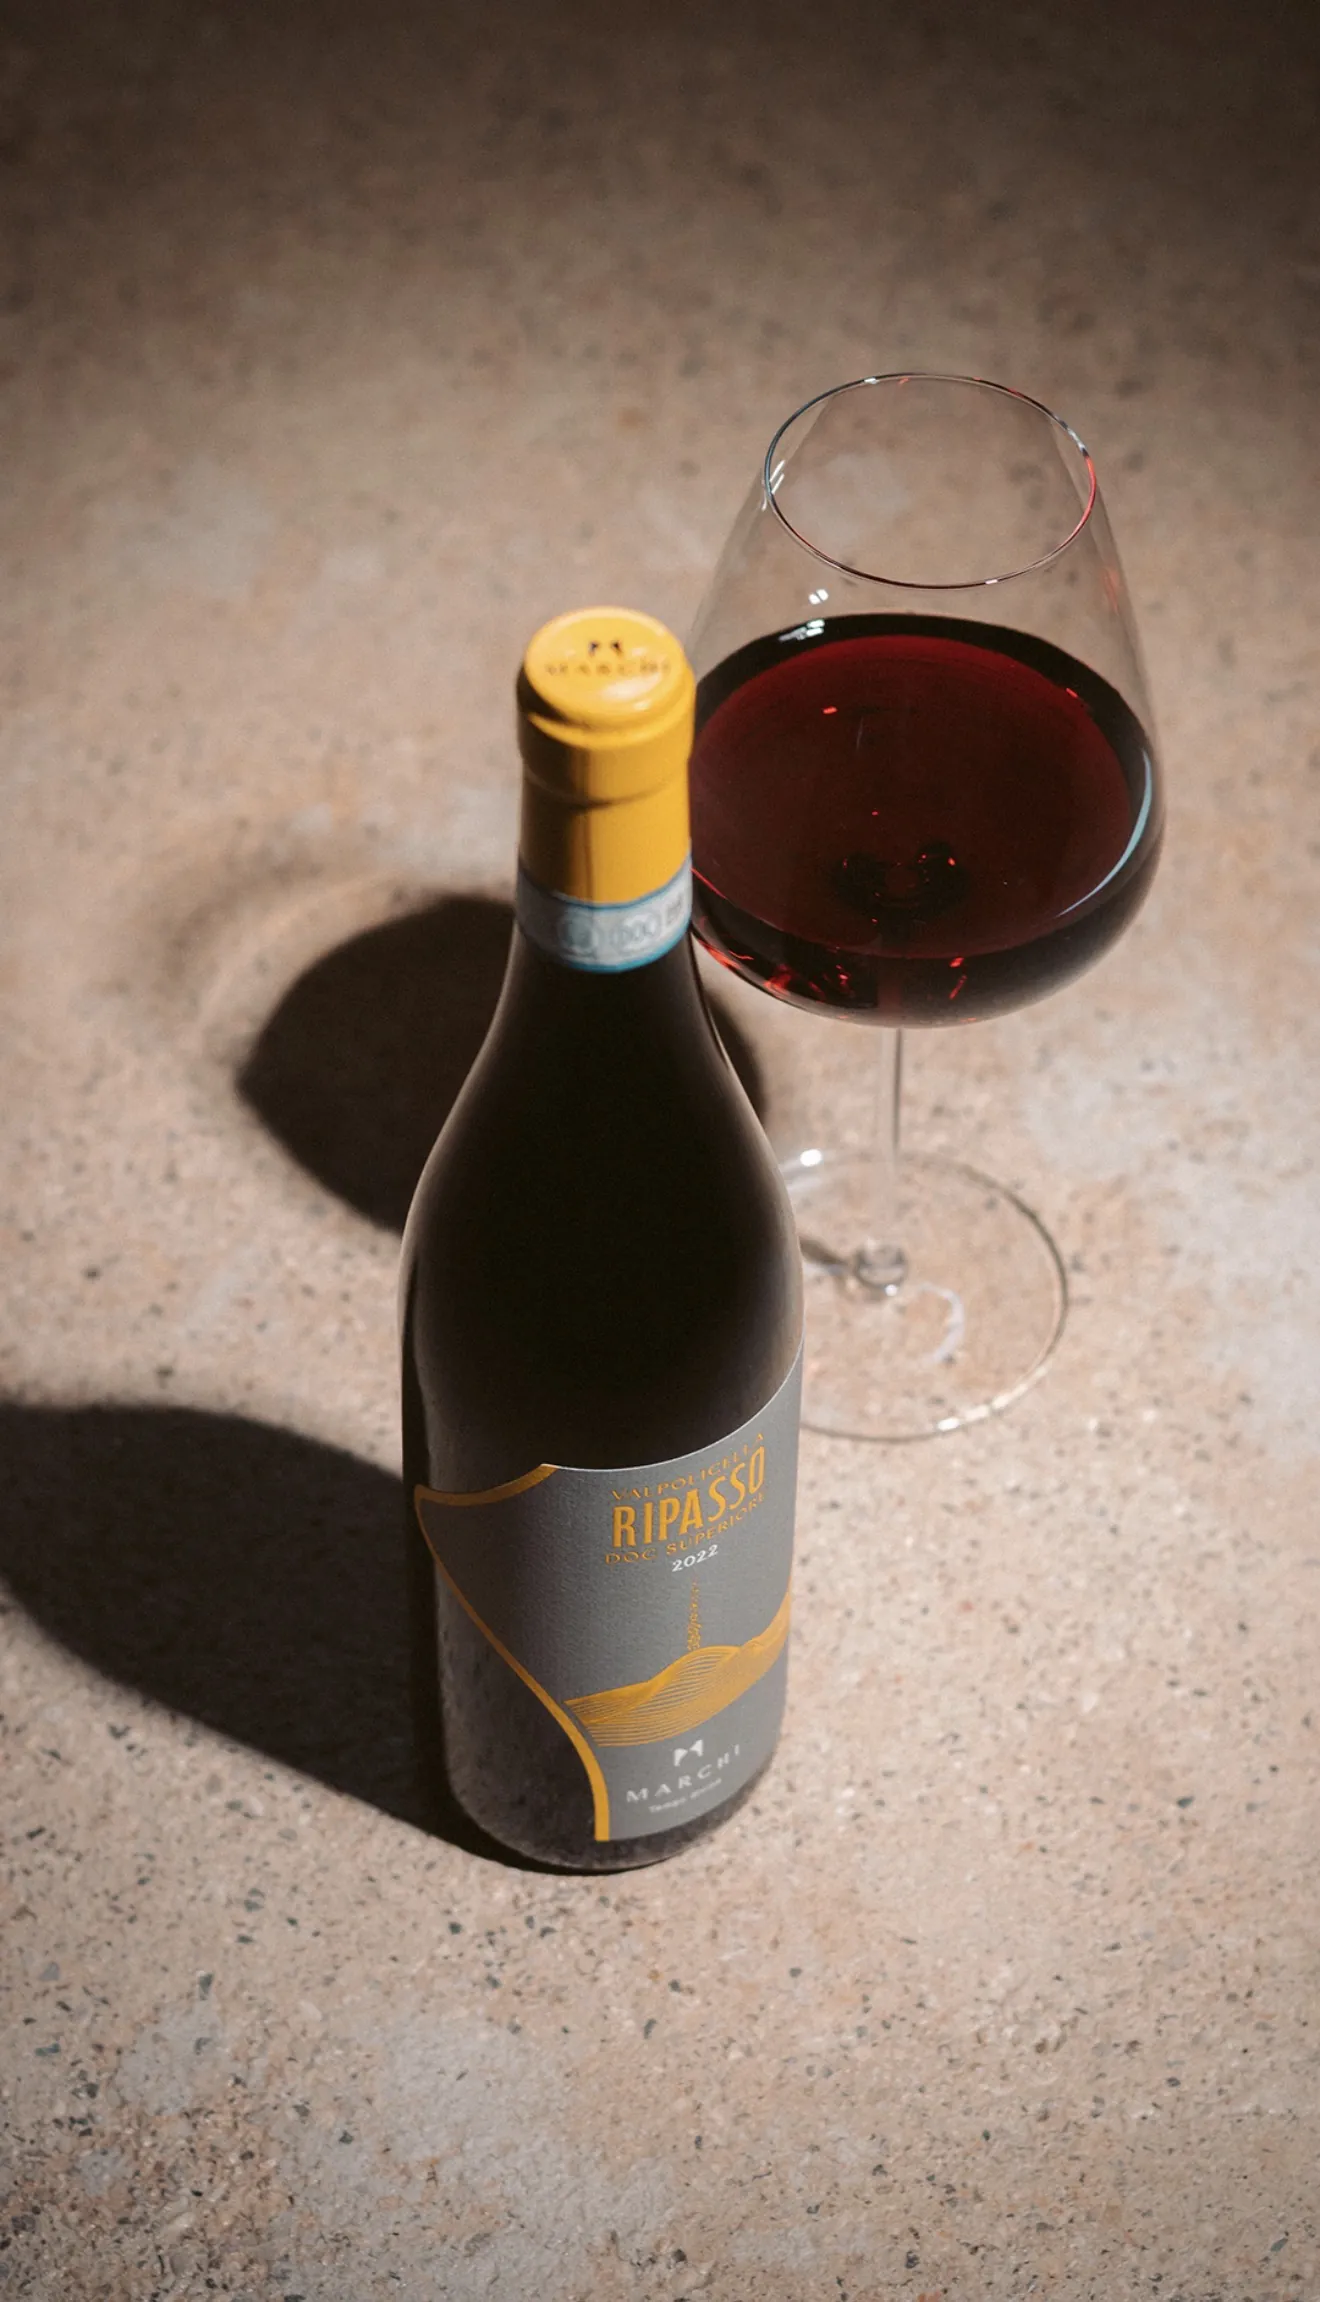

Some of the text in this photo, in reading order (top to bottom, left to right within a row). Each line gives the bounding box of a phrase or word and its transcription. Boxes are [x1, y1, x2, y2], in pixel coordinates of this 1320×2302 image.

[612, 1432, 764, 1500] VALPOLICELLA
[612, 1446, 765, 1548] RIPASSO
[605, 1492, 764, 1565] DOC SUPERIORE
[671, 1544, 718, 1572] 2022
[626, 1744, 741, 1802] MARCHI
